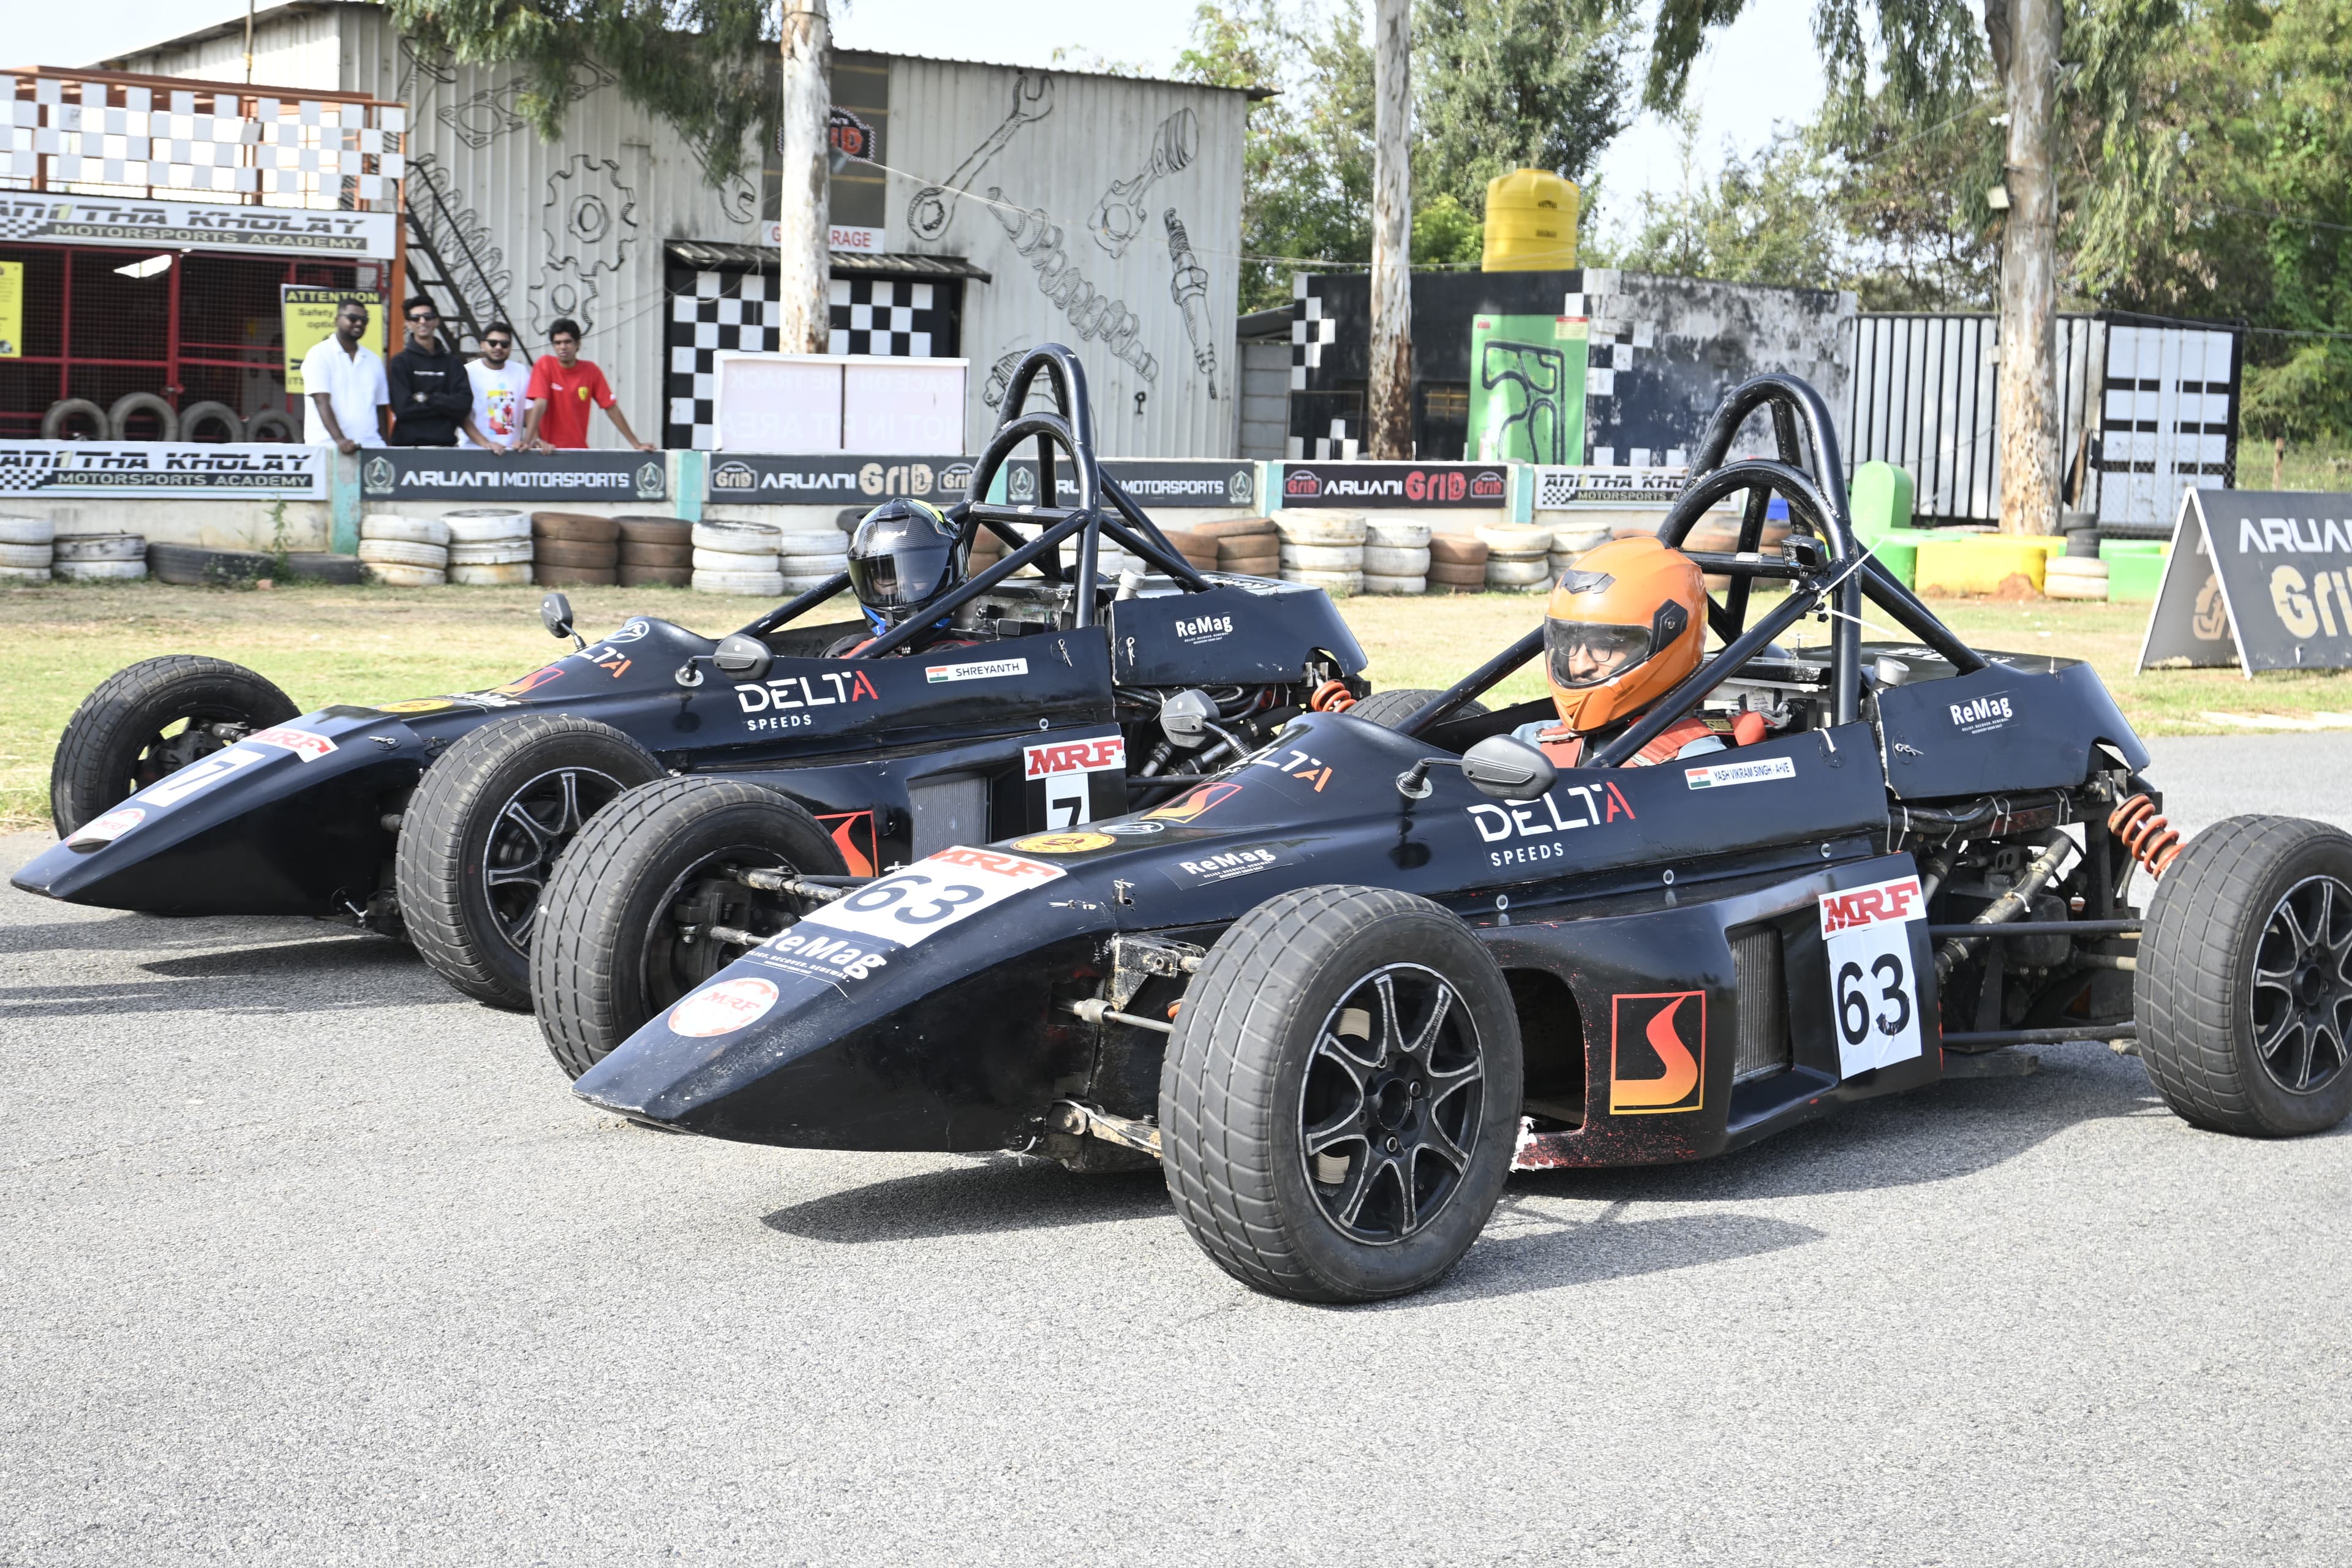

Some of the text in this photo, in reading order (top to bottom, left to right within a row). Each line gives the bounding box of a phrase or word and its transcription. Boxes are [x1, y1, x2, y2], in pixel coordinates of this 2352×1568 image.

[188, 210, 365, 235] KHOLAY
[55, 224, 361, 249] MOTORSPORTS ACADEMY
[286, 291, 379, 303] ATTENTION
[298, 309, 333, 317] Safety
[0, 450, 312, 471] ANITHA KHOLAY
[58, 473, 309, 486] MOTORSPORTS ACADEMY
[400, 470, 630, 488] ARUANI MOTORSPORTS
[761, 473, 856, 489] ARUANI
[1121, 480, 1224, 496] MOTORSPORTS
[1324, 480, 1403, 496] ARUANI
[1545, 474, 1632, 488] ANITHA
[1578, 491, 1666, 501] MOTORSPORTS
[1175, 616, 1233, 638] ReMag
[956, 663, 1020, 677] SHREYANTH
[734, 670, 879, 713] DELTA
[1950, 698, 2013, 725] ReMag
[747, 714, 812, 731] SPEEDS
[1028, 740, 1123, 776] MRF
[167, 761, 237, 791] 7
[1714, 771, 1730, 782] YASH
[1730, 768, 1753, 780] VIKRAM
[1754, 765, 1772, 777] SINGH
[1052, 796, 1082, 828] 7
[1467, 782, 1636, 842] DELTA
[97, 821, 127, 831] MRF
[928, 848, 1058, 877] MRF
[1180, 849, 1276, 875] ReMag
[1491, 842, 1564, 867] SPEEDS
[843, 875, 985, 924] 63
[1823, 881, 1918, 933] MRF
[770, 955, 807, 968] RECOVER.
[703, 992, 761, 1011] MRF
[1838, 954, 1910, 1046] 63
